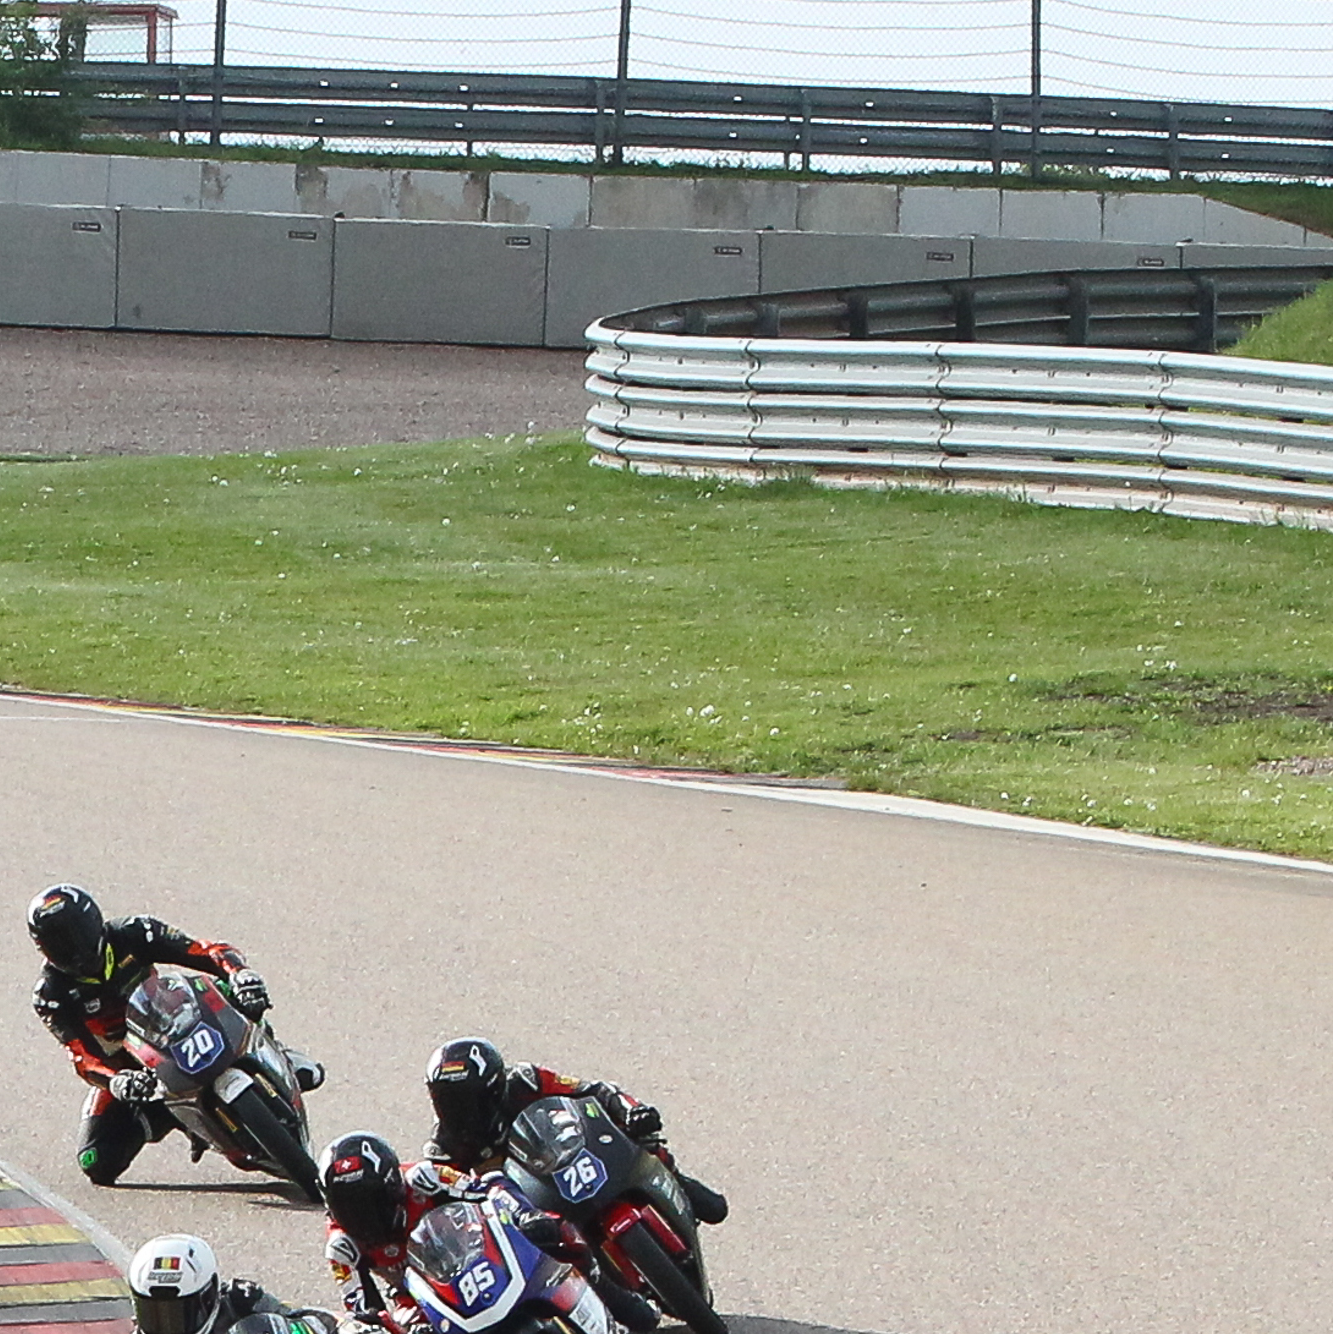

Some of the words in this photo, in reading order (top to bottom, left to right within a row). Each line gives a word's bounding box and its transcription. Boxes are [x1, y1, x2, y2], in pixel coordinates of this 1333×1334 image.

[181, 1029, 214, 1068] 20
[563, 1156, 597, 1197] 26
[458, 1261, 496, 1307] 85
